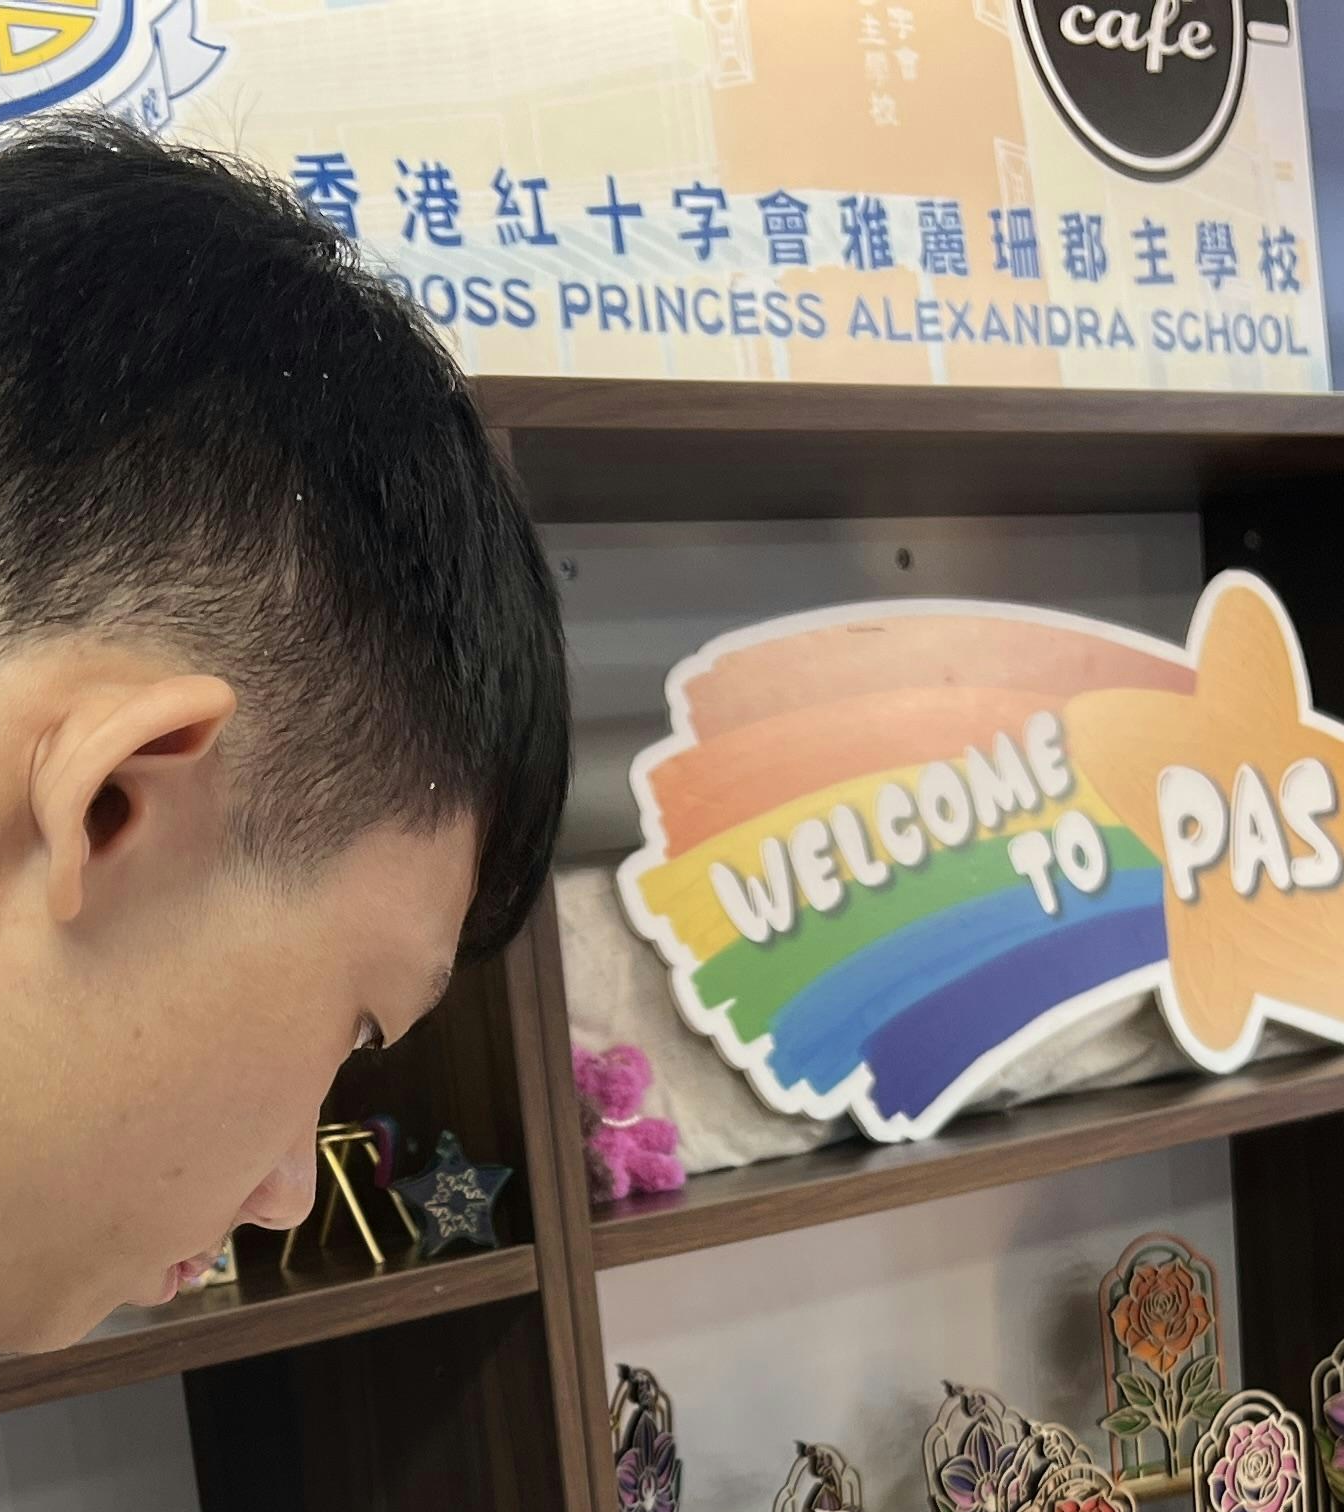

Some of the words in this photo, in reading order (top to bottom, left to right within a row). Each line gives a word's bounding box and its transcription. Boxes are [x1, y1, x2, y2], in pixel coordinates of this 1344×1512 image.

[293, 151, 1303, 294] 香港紅十字會雅麗珊郡主學校
[559, 281, 825, 339] PRINCESS
[848, 297, 1136, 348] ALEXANDRA
[1151, 310, 1310, 356] SCHOOL
[709, 711, 1075, 943] WELCOME
[1007, 810, 1108, 915] TO
